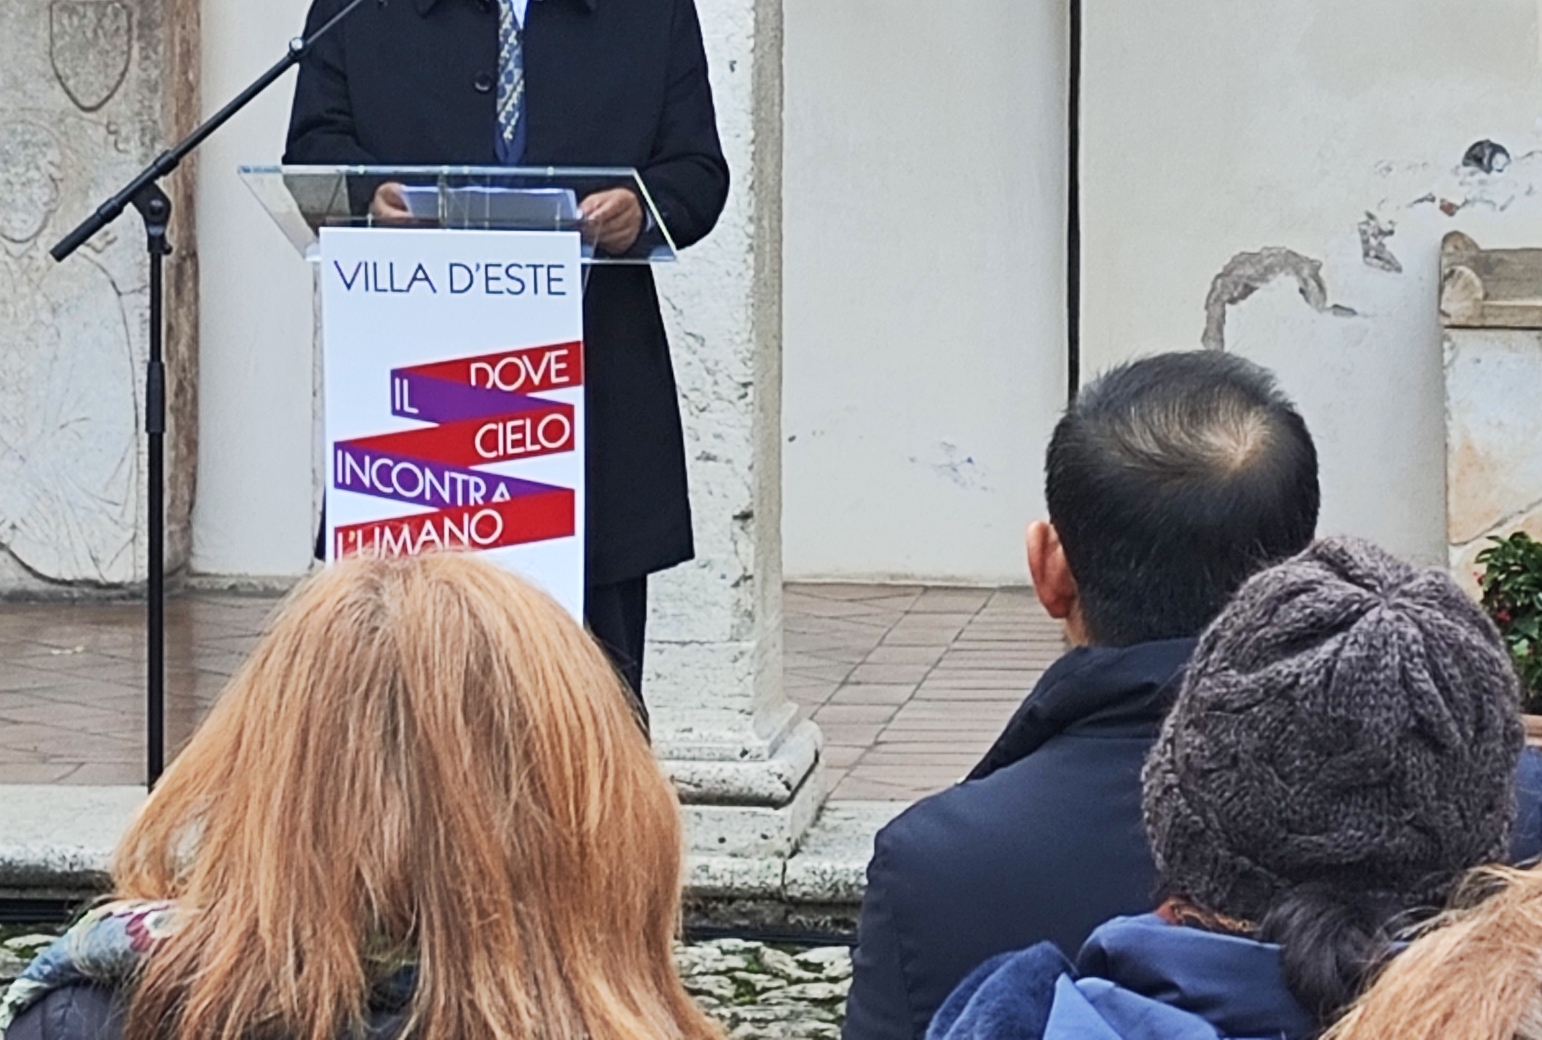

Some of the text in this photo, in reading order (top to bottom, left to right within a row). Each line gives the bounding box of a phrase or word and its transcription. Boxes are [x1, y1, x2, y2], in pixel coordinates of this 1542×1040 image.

[333, 259, 567, 296] VILLA D'ESTE
[469, 348, 570, 392] DOVE
[394, 377, 420, 415] IL
[474, 413, 571, 459] CIELO
[336, 449, 512, 507] INCONTRA
